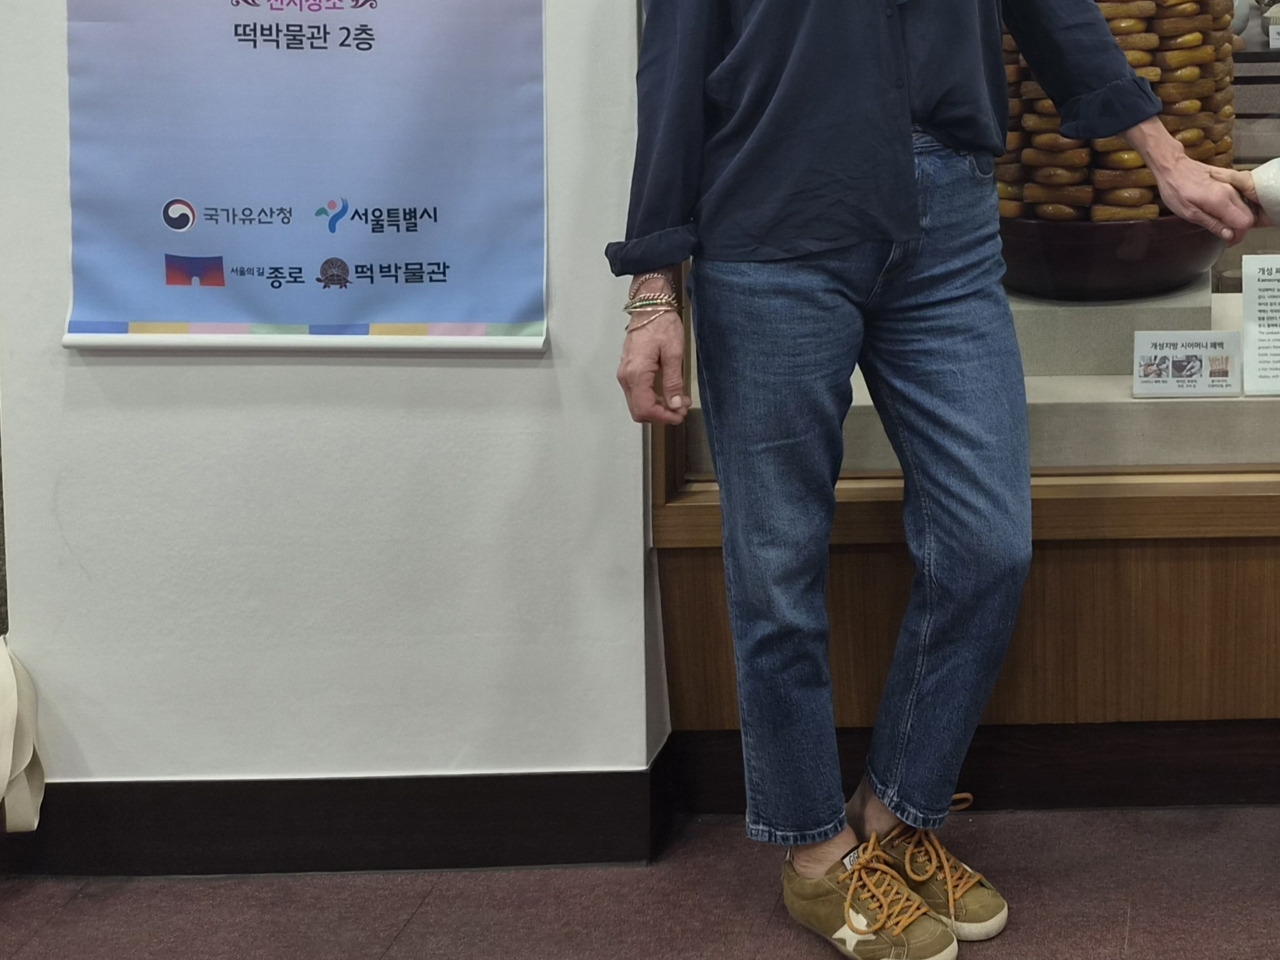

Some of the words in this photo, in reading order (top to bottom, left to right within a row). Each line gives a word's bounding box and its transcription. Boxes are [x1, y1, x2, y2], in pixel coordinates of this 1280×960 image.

[339, 25, 375, 51] 2층
[204, 207, 292, 225] 국가유산청
[351, 207, 437, 233] 서울특별시
[266, 267, 305, 289] 종로
[1257, 266, 1273, 277] 개성
[1150, 341, 1179, 351] 개성지방
[1180, 341, 1209, 350] 시어머니
